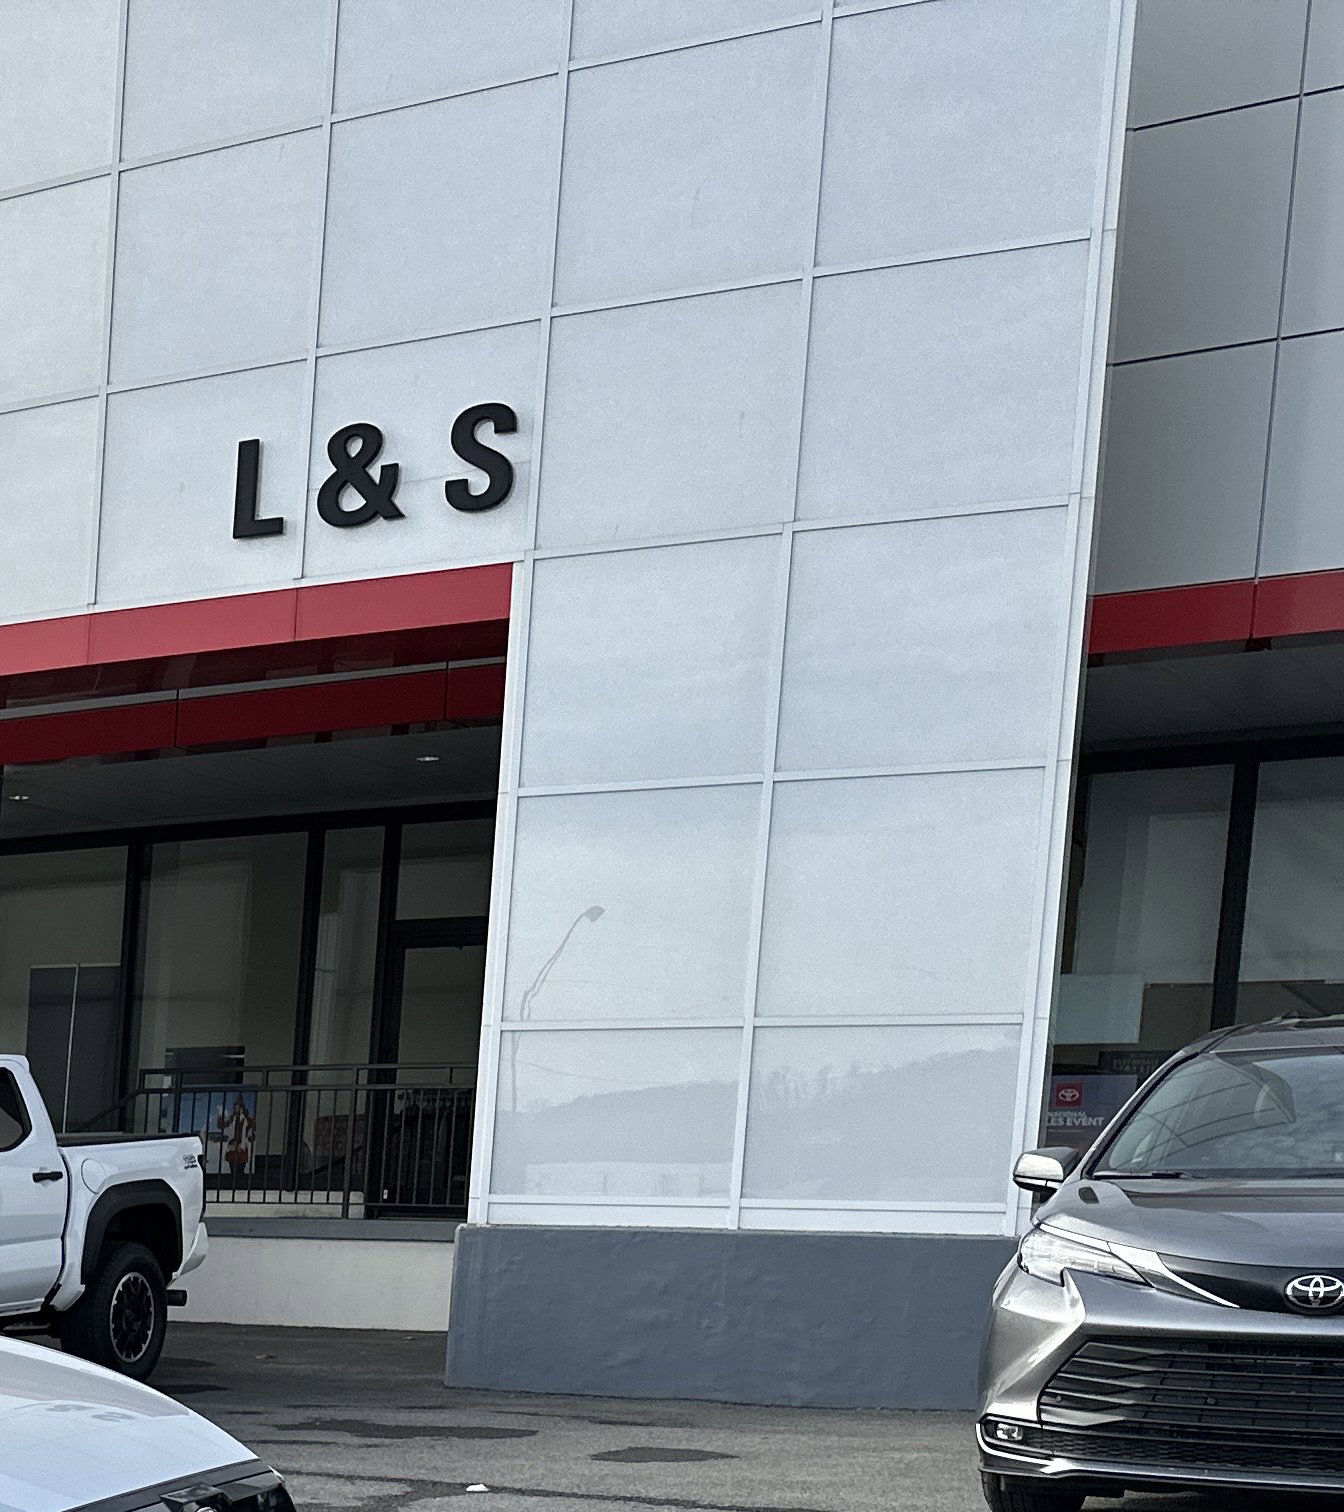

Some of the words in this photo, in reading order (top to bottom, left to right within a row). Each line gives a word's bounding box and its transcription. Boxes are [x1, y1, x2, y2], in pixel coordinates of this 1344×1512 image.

[233, 438, 284, 539] L
[316, 422, 405, 528] &
[445, 402, 518, 512] S
[1066, 1116, 1105, 1126] EVENT
